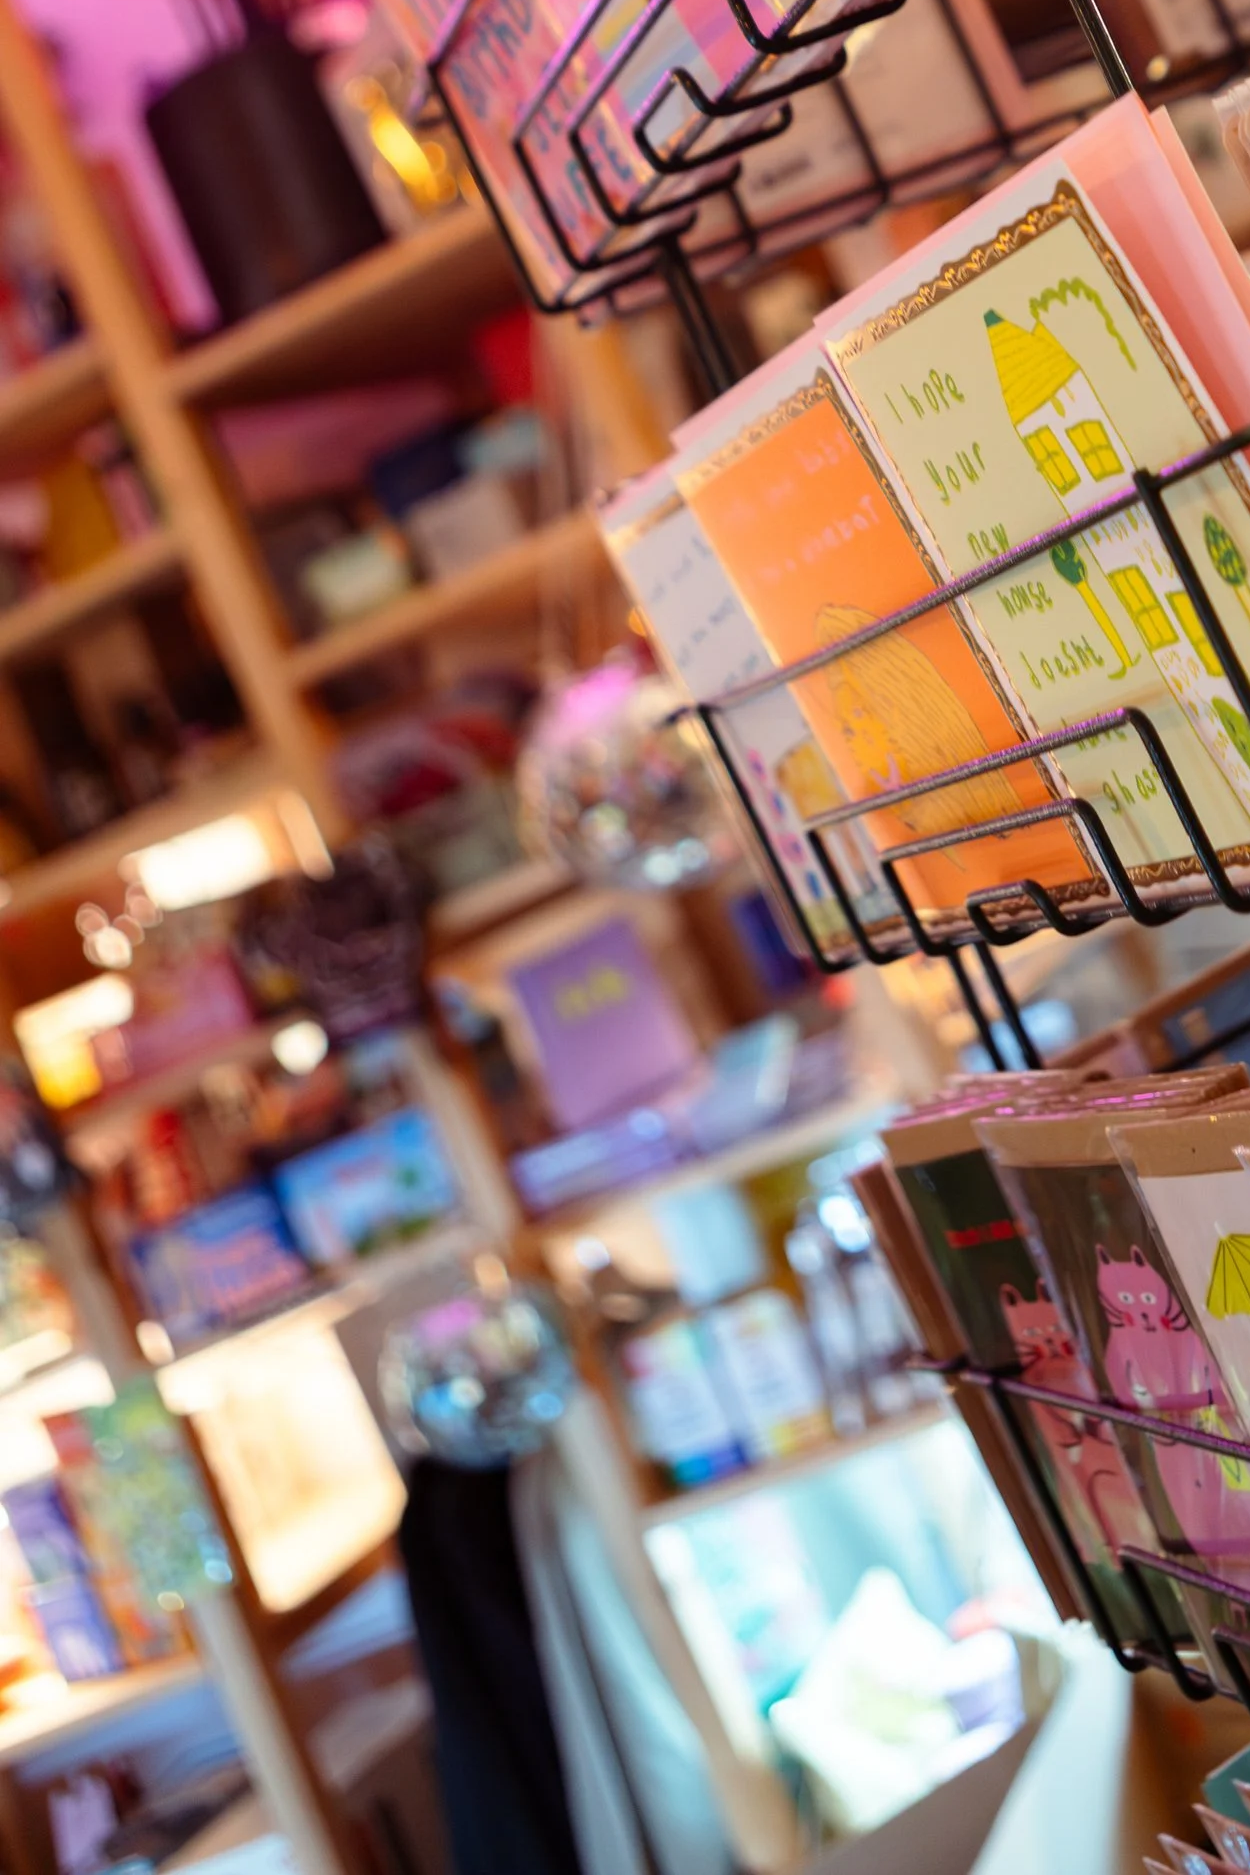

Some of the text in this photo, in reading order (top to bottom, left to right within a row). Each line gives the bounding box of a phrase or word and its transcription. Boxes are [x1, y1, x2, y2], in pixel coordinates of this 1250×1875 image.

[900, 368, 966, 420] hope
[923, 441, 986, 507] your
[967, 522, 1011, 561] new
[997, 579, 1054, 620] house
